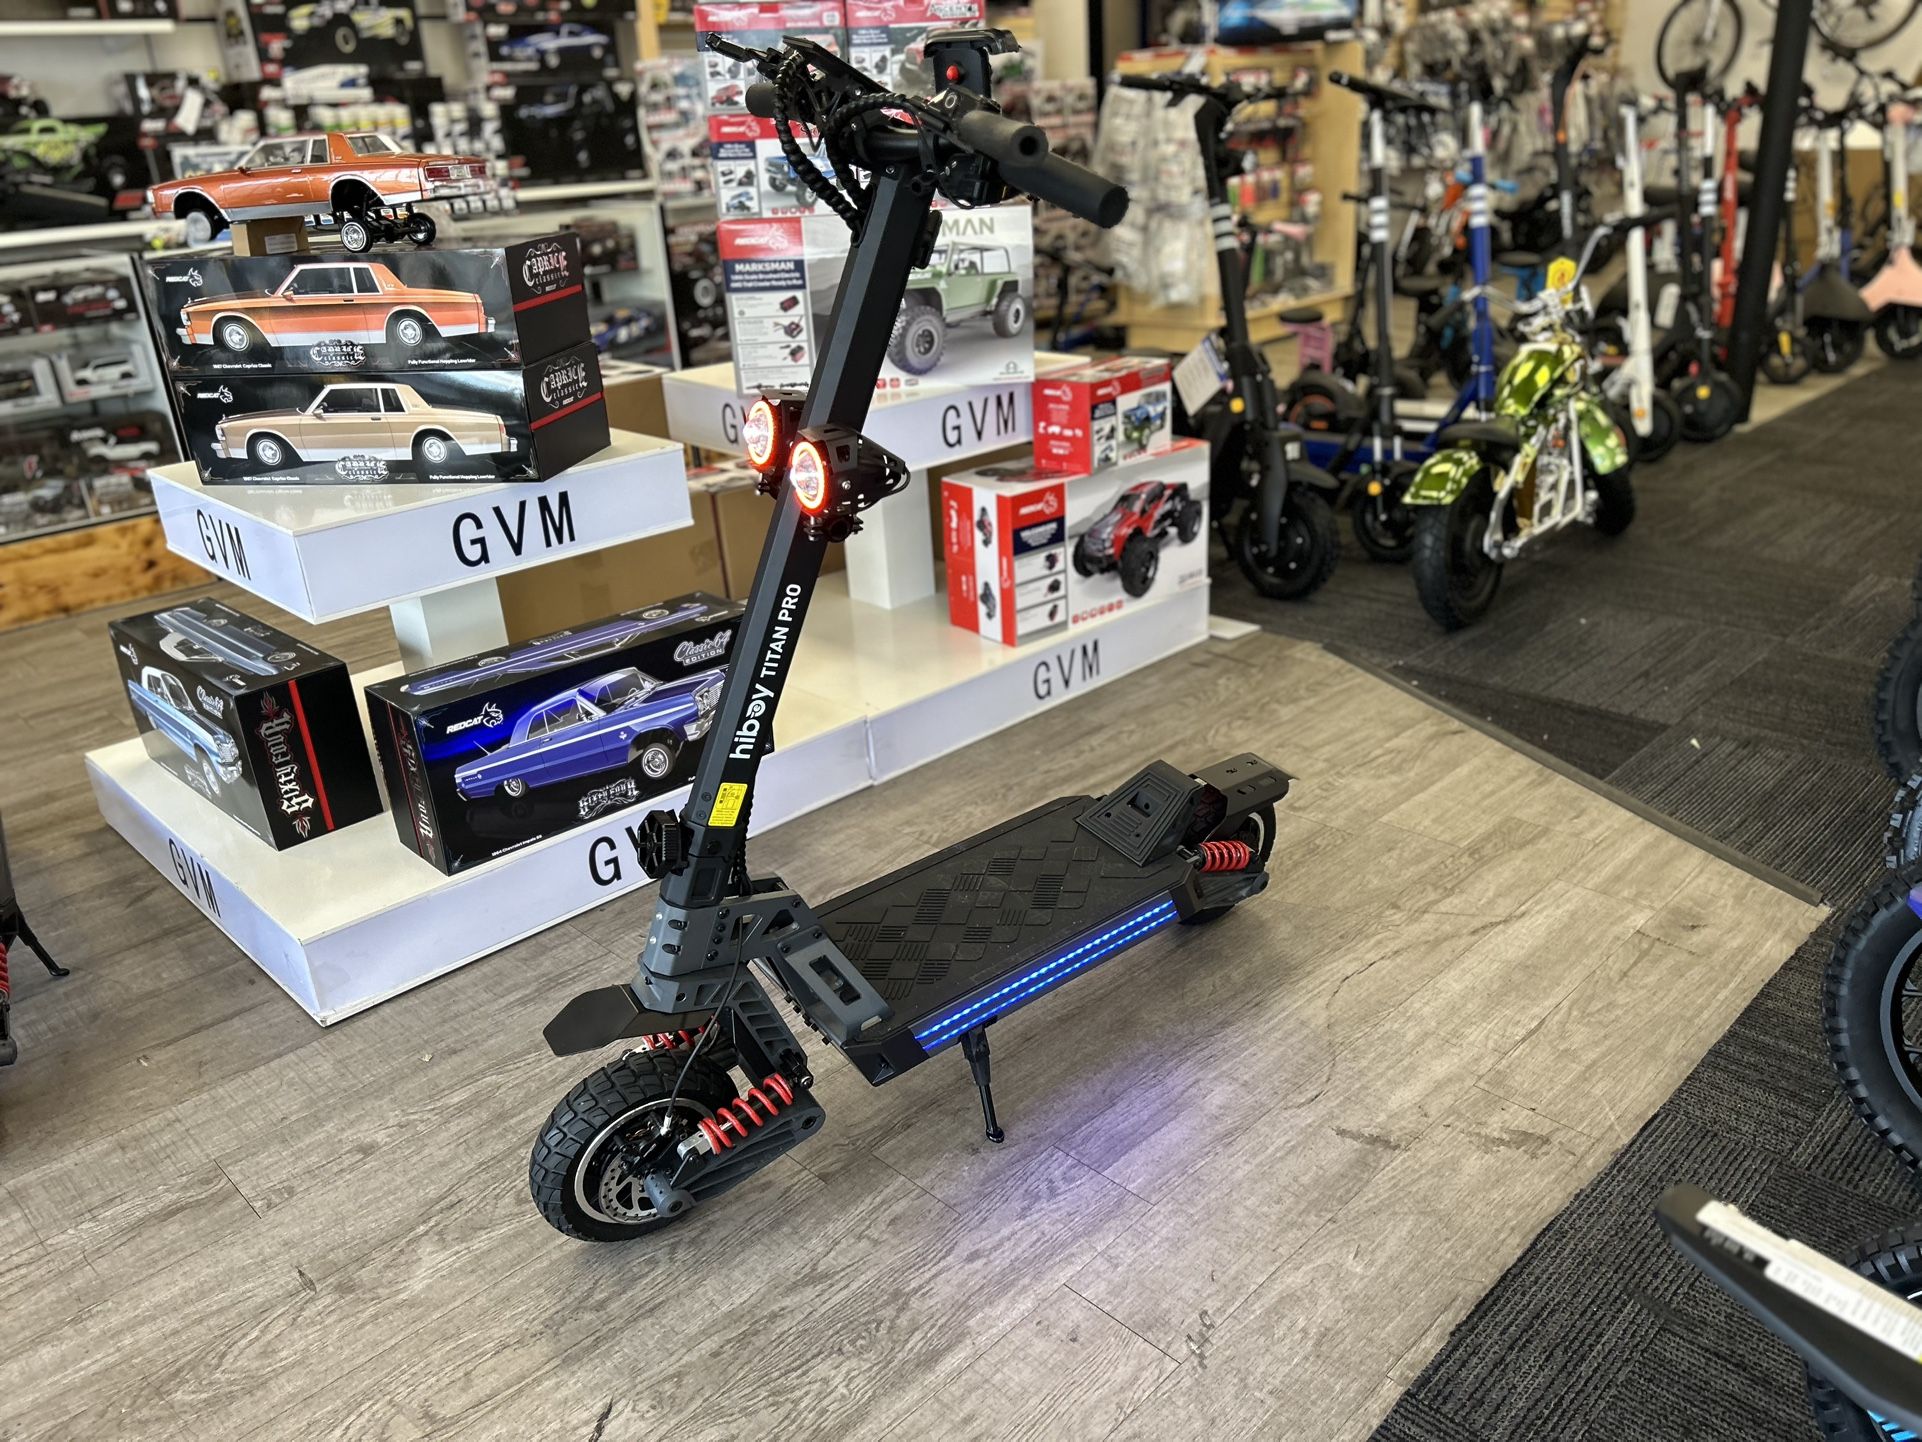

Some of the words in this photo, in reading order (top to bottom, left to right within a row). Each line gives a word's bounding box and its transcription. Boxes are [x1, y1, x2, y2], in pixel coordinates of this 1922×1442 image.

[942, 217, 995, 236] MAN
[734, 261, 795, 273] MARKSMAN
[942, 391, 1016, 448] GVM
[197, 508, 252, 581] GVM
[453, 490, 576, 567] GVM
[685, 648, 722, 664] EDITION
[729, 683, 774, 759] hiboy
[760, 626, 790, 679] TITAN
[778, 583, 802, 622] PRO
[1033, 639, 1100, 700] GVM
[446, 715, 484, 734] REDCAT
[168, 837, 222, 918] GVM
